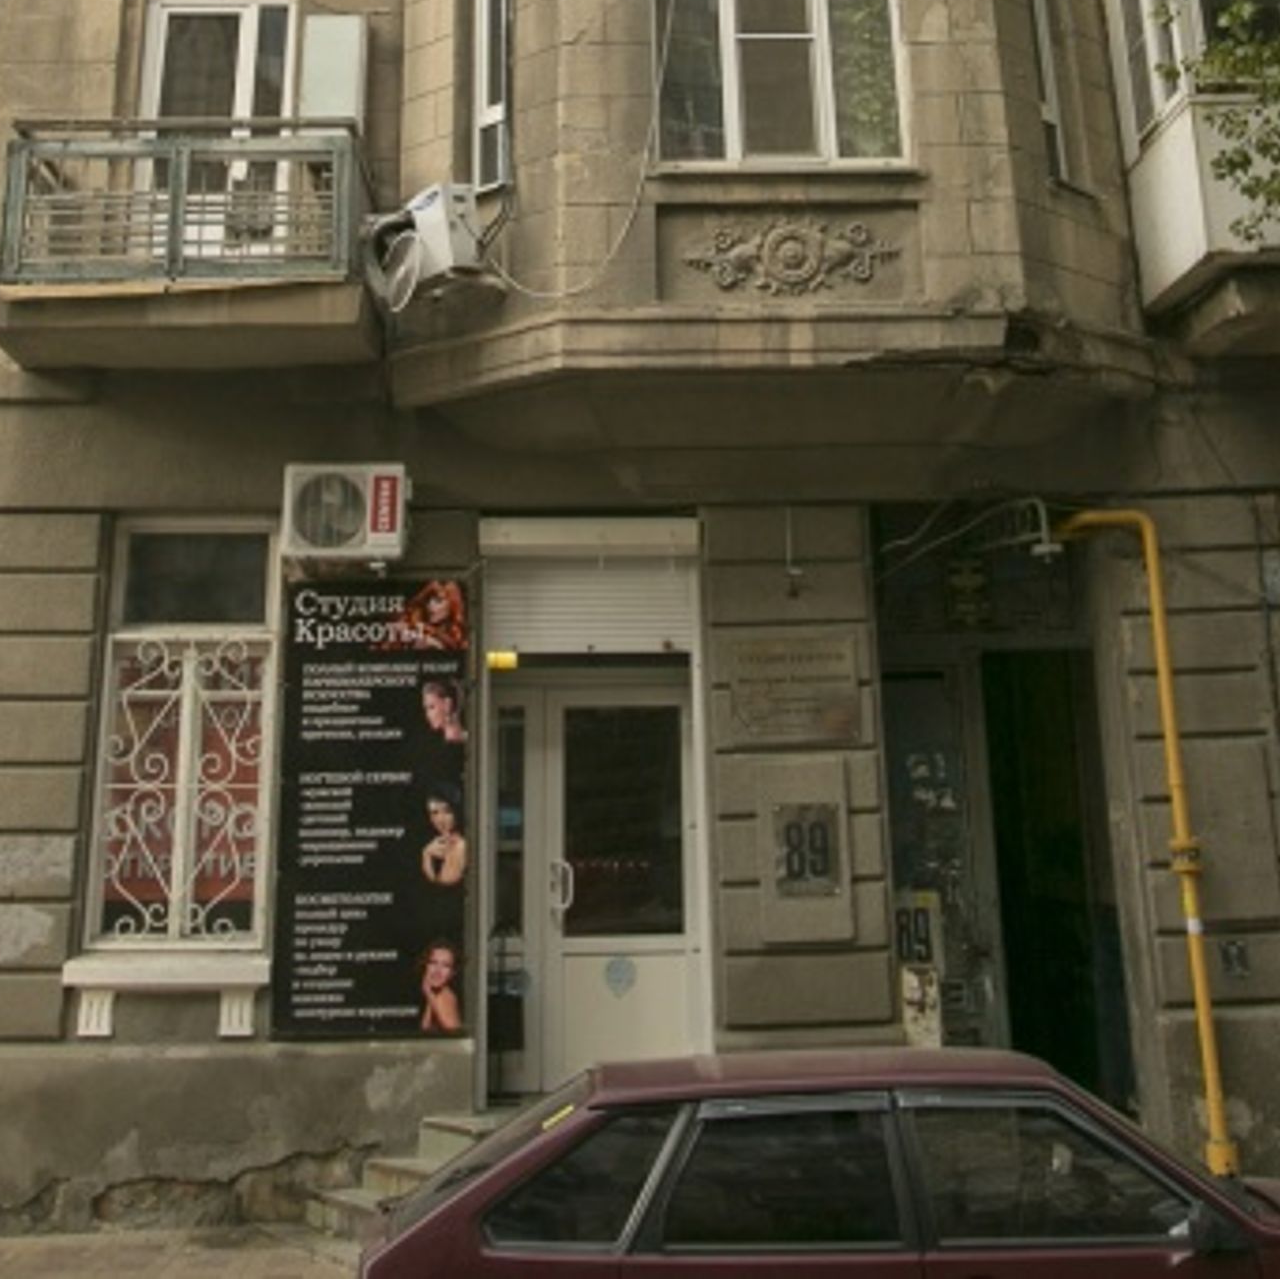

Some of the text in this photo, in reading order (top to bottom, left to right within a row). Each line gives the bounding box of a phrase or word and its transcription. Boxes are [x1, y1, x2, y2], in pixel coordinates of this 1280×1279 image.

[294, 589, 406, 620] Студия
[294, 619, 425, 650] Красоты
[784, 822, 829, 879] 89
[896, 908, 933, 963] 89
